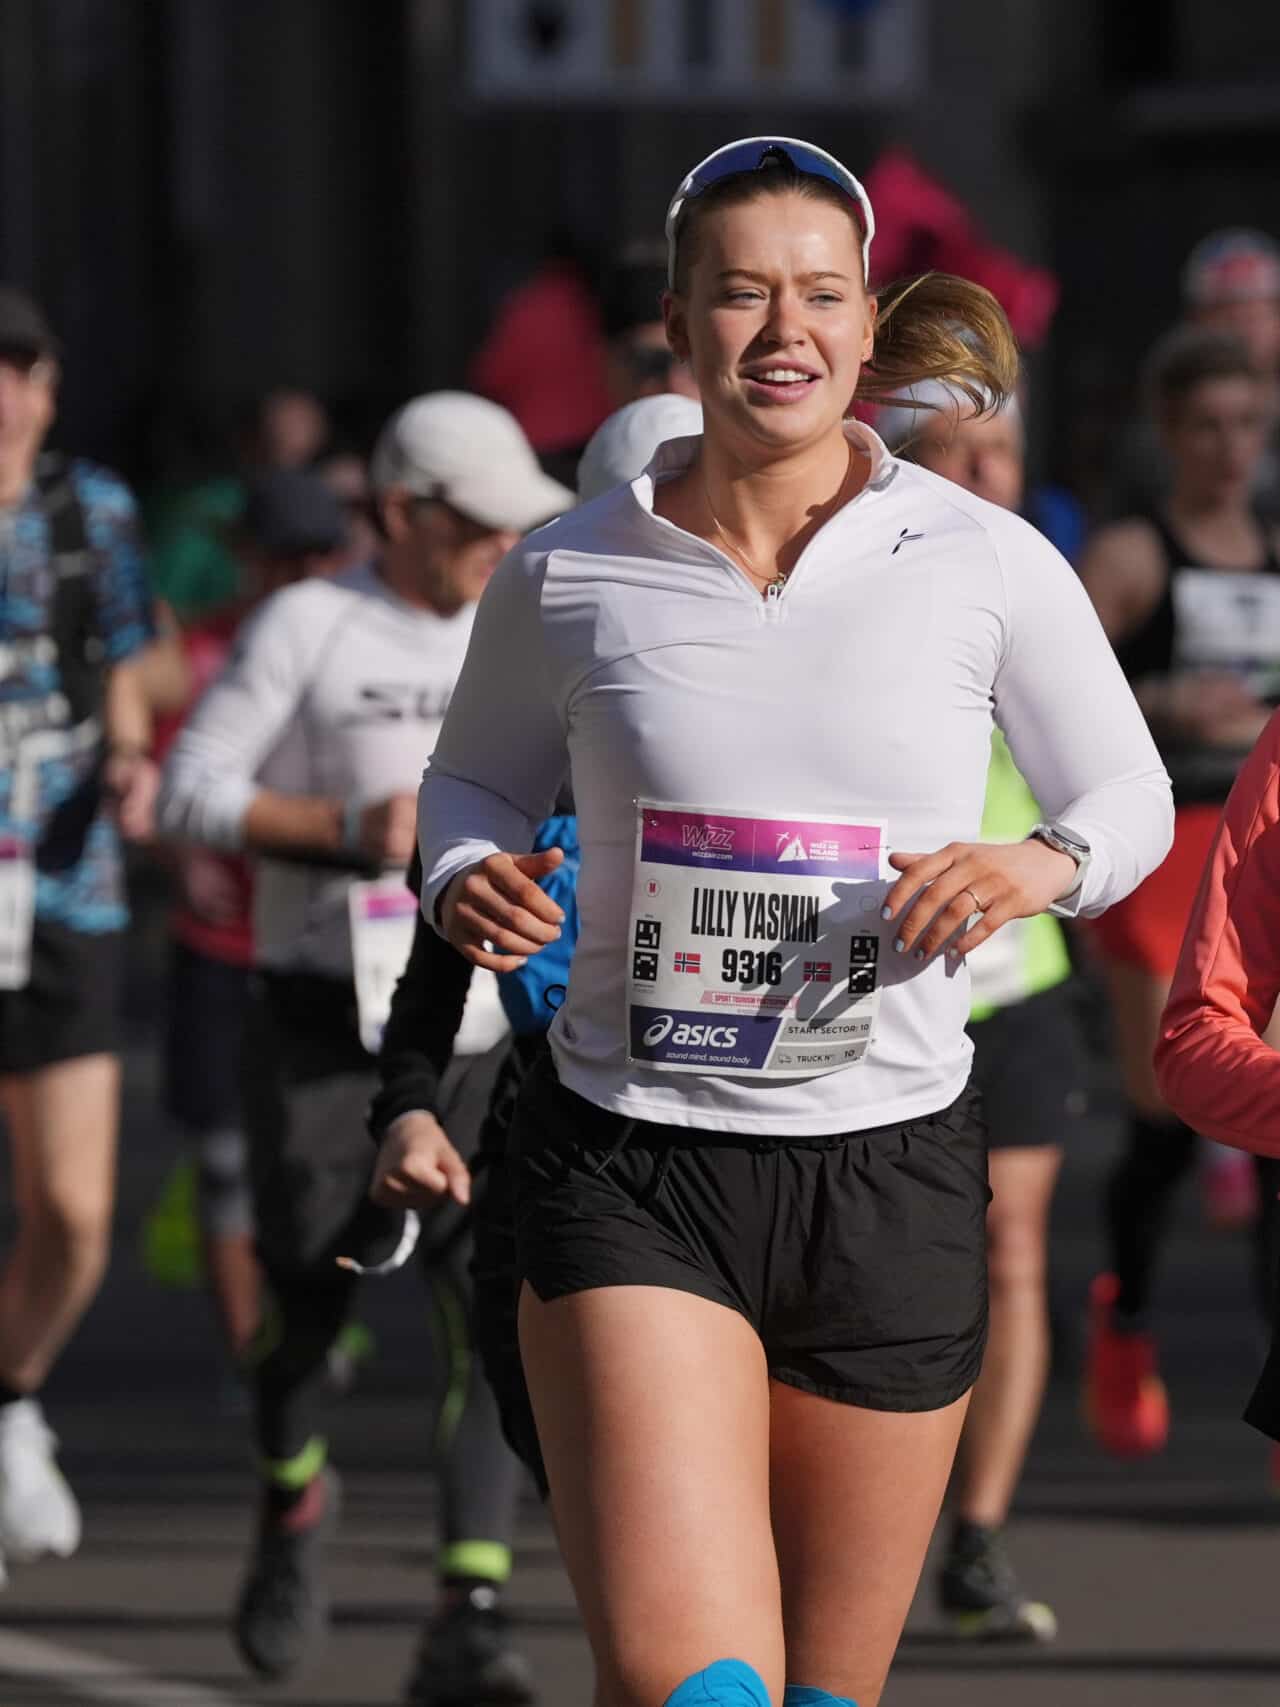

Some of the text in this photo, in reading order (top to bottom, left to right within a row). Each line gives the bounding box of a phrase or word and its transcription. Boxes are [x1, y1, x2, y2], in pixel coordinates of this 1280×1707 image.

[691, 887, 819, 942] LILLY YASMIN
[721, 948, 782, 986] 9316
[788, 1025, 818, 1034] START
[861, 1023, 869, 1031] 10
